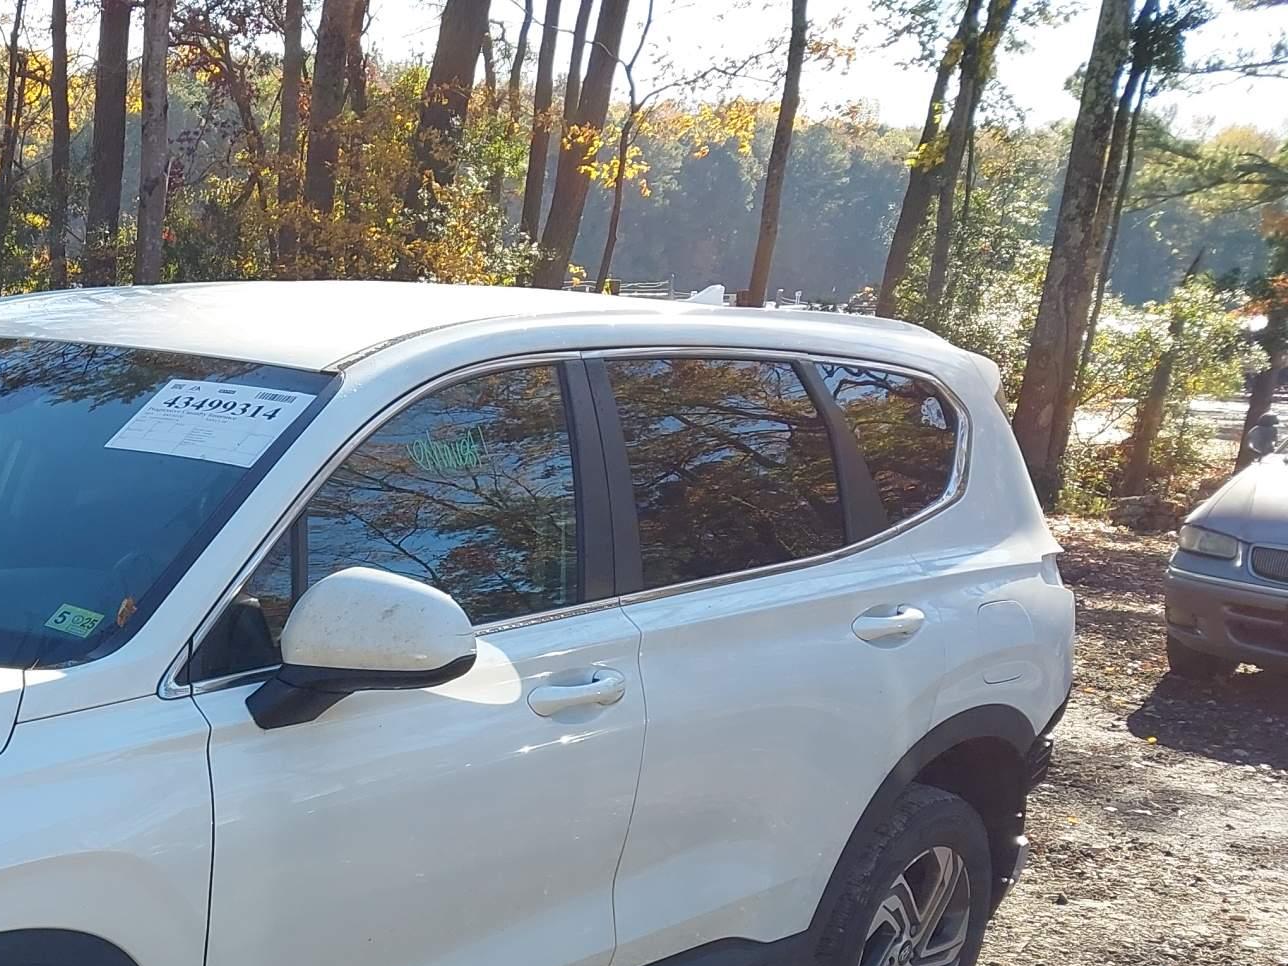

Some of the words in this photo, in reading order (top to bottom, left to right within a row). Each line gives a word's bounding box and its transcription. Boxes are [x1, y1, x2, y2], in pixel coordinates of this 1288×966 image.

[163, 395, 282, 421] 43499314
[54, 610, 71, 624] 5
[79, 617, 98, 629] 25
